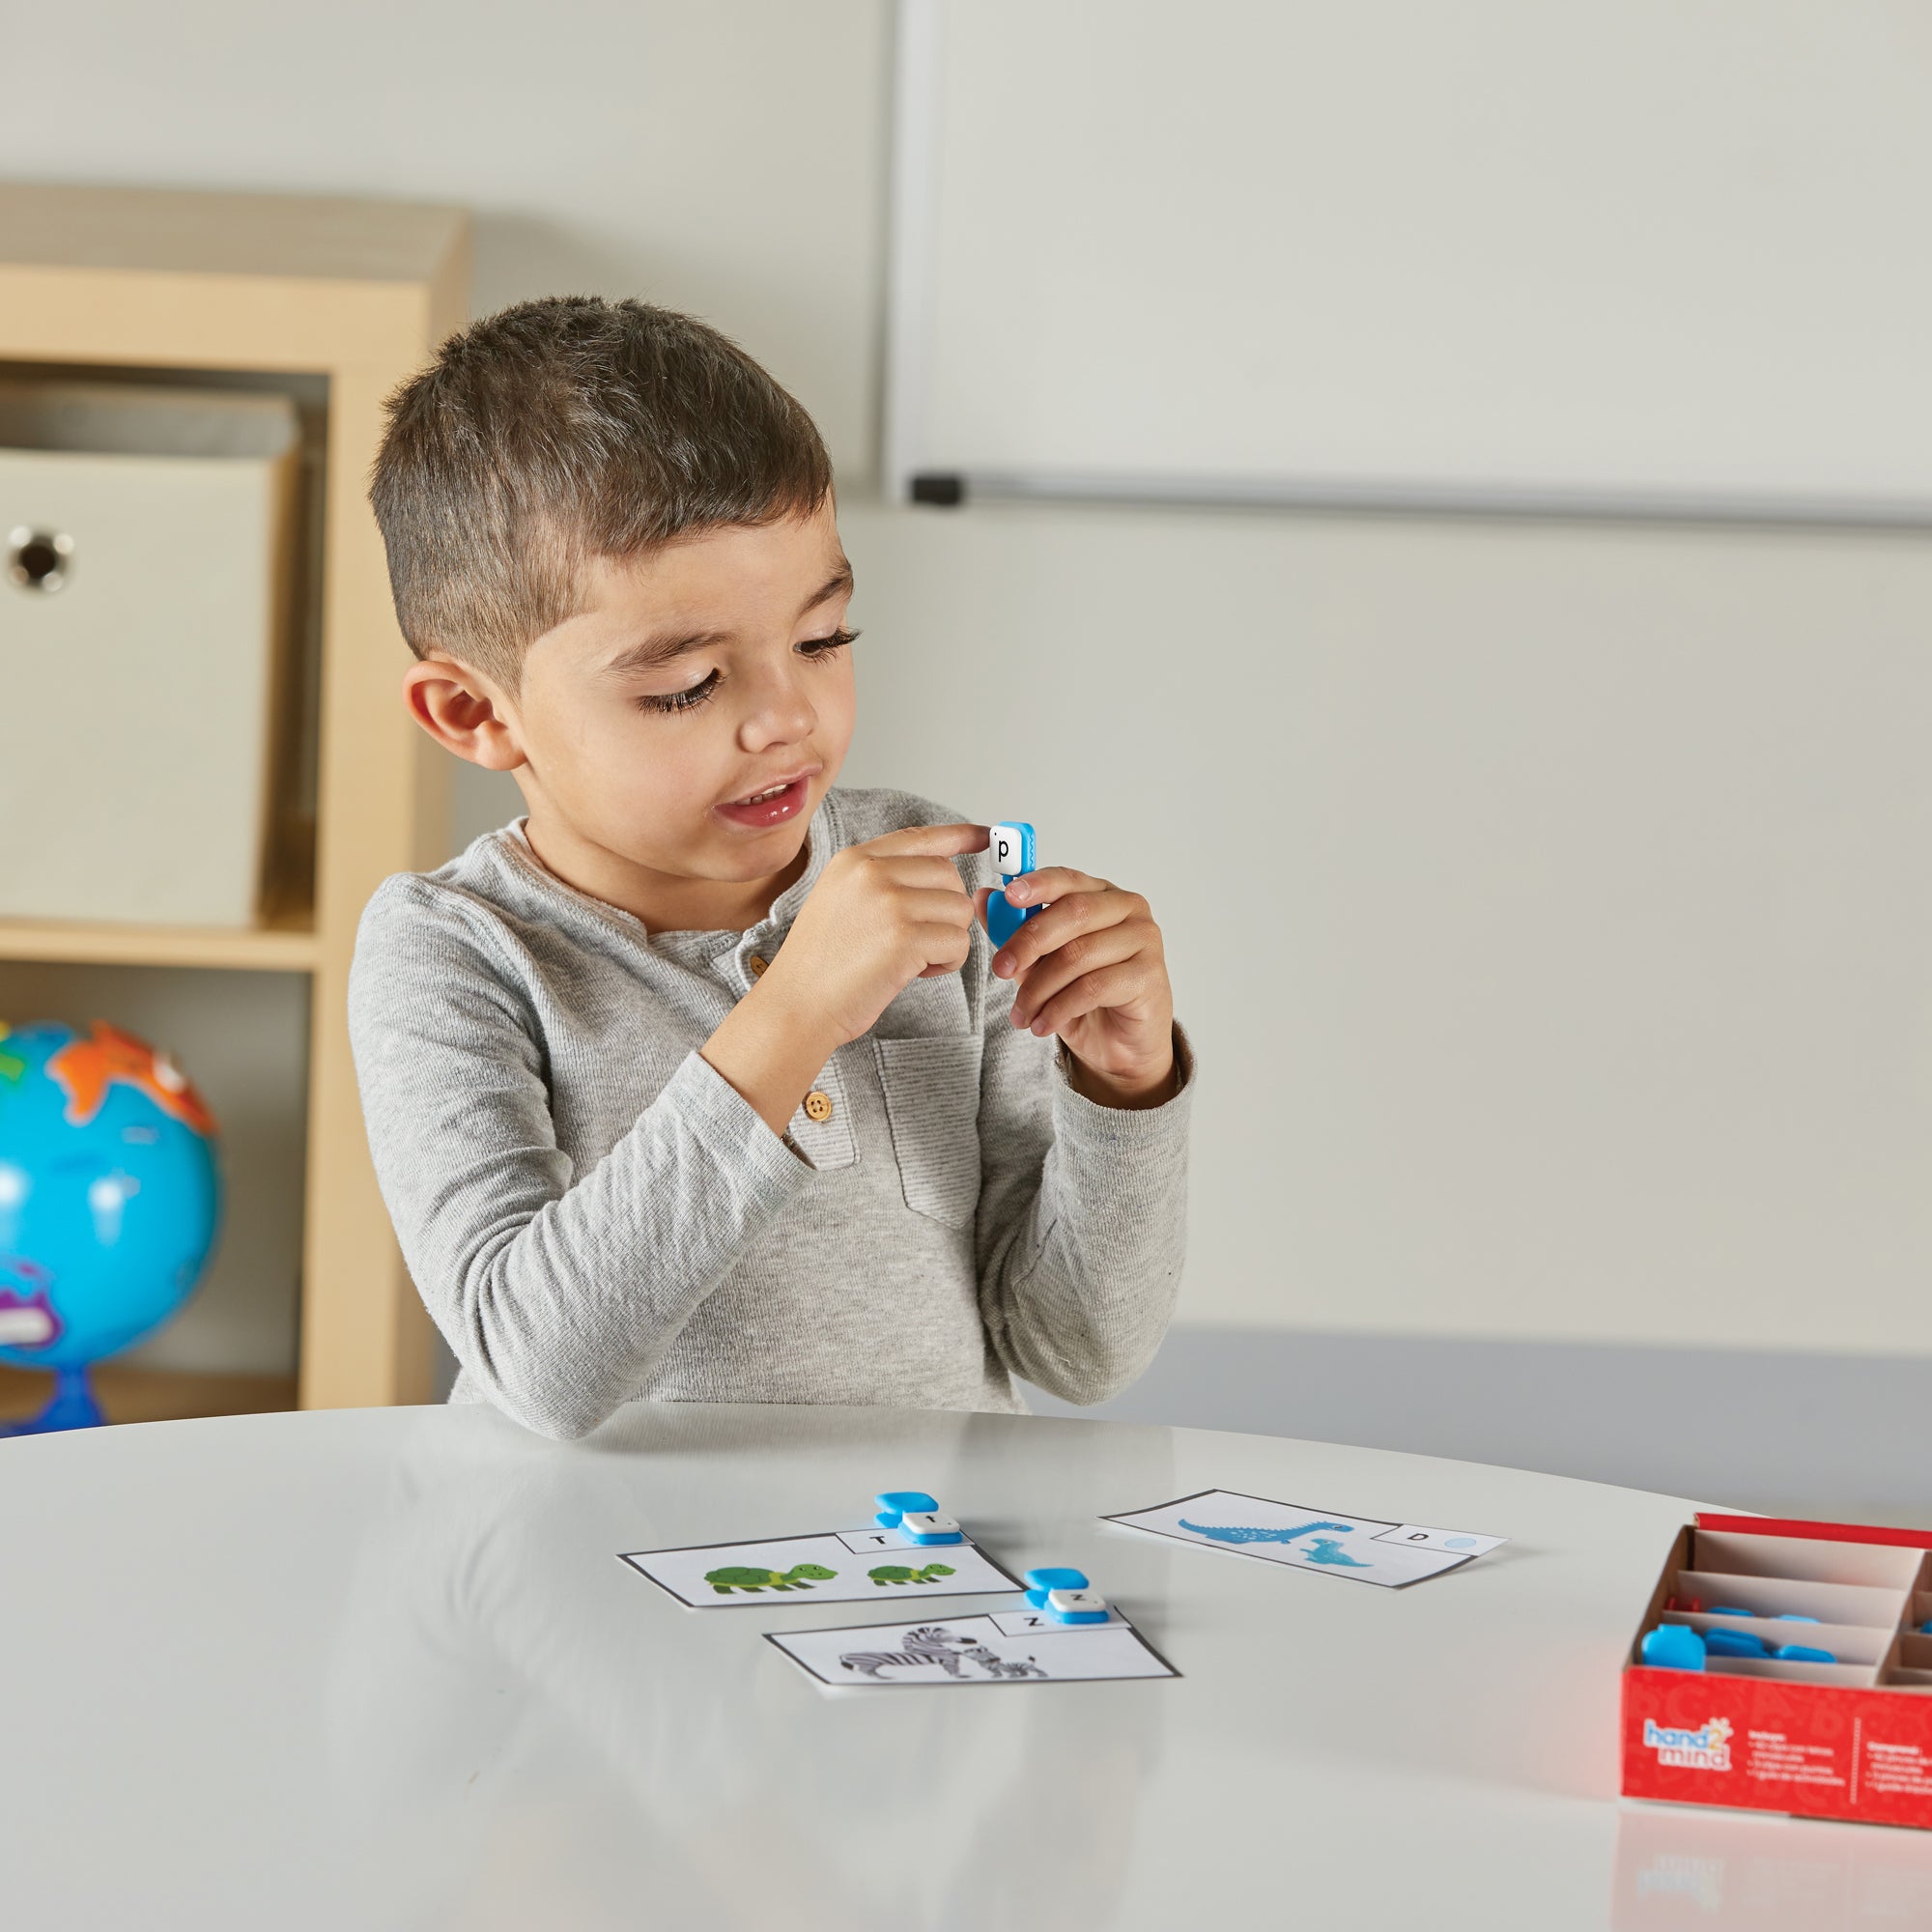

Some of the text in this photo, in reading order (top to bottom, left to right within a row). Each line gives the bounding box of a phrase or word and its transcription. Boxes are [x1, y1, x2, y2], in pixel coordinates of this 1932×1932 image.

[998, 840, 1009, 863] p
[925, 1515, 936, 1523] t
[869, 1535, 886, 1545] T
[1406, 1533, 1430, 1542] D
[1660, 1745, 1727, 1767] mind
